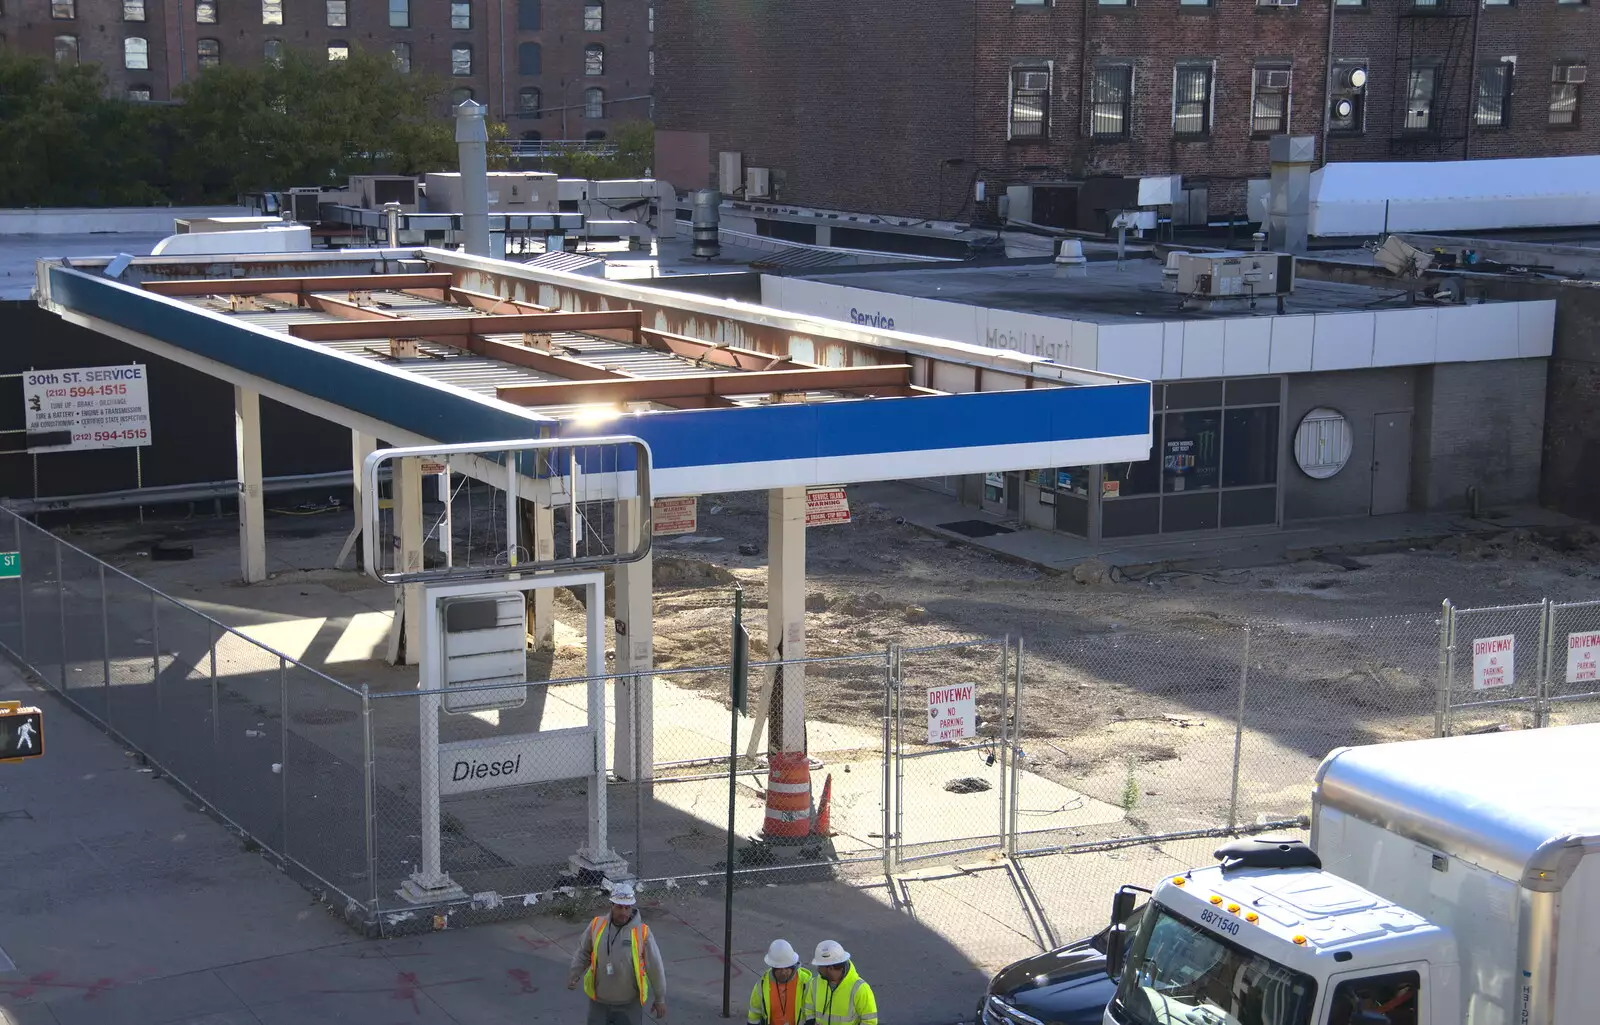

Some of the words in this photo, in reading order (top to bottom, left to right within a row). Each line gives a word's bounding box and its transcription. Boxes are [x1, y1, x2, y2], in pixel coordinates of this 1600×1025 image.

[851, 307, 894, 330] Service
[28, 374, 59, 385] 30th
[63, 372, 82, 383] ST.
[86, 368, 142, 382] SERVICE
[46, 388, 67, 398] (212)
[70, 383, 127, 398] 594-1515
[53, 411, 74, 419] BATTERY
[105, 406, 141, 415] TRANSMISSION
[73, 433, 92, 442] (212)
[94, 428, 147, 441] 594-1515
[4, 555, 15, 566] ST
[1475, 639, 1512, 655] DRIVEWAY
[1490, 656, 1497, 665] NO
[1584, 651, 1591, 659] NO
[1483, 666, 1503, 676] PARKING
[1576, 660, 1596, 670] PARKING
[1483, 675, 1504, 686] ANYTIME
[1576, 670, 1596, 680] ANYTIME
[930, 687, 972, 705] DRIVEWAY
[947, 707, 955, 716] NO
[940, 716, 964, 729] PARKING
[940, 728, 964, 740] ANYTIME
[452, 754, 521, 781] Diesel
[1200, 908, 1240, 936] 8871540
